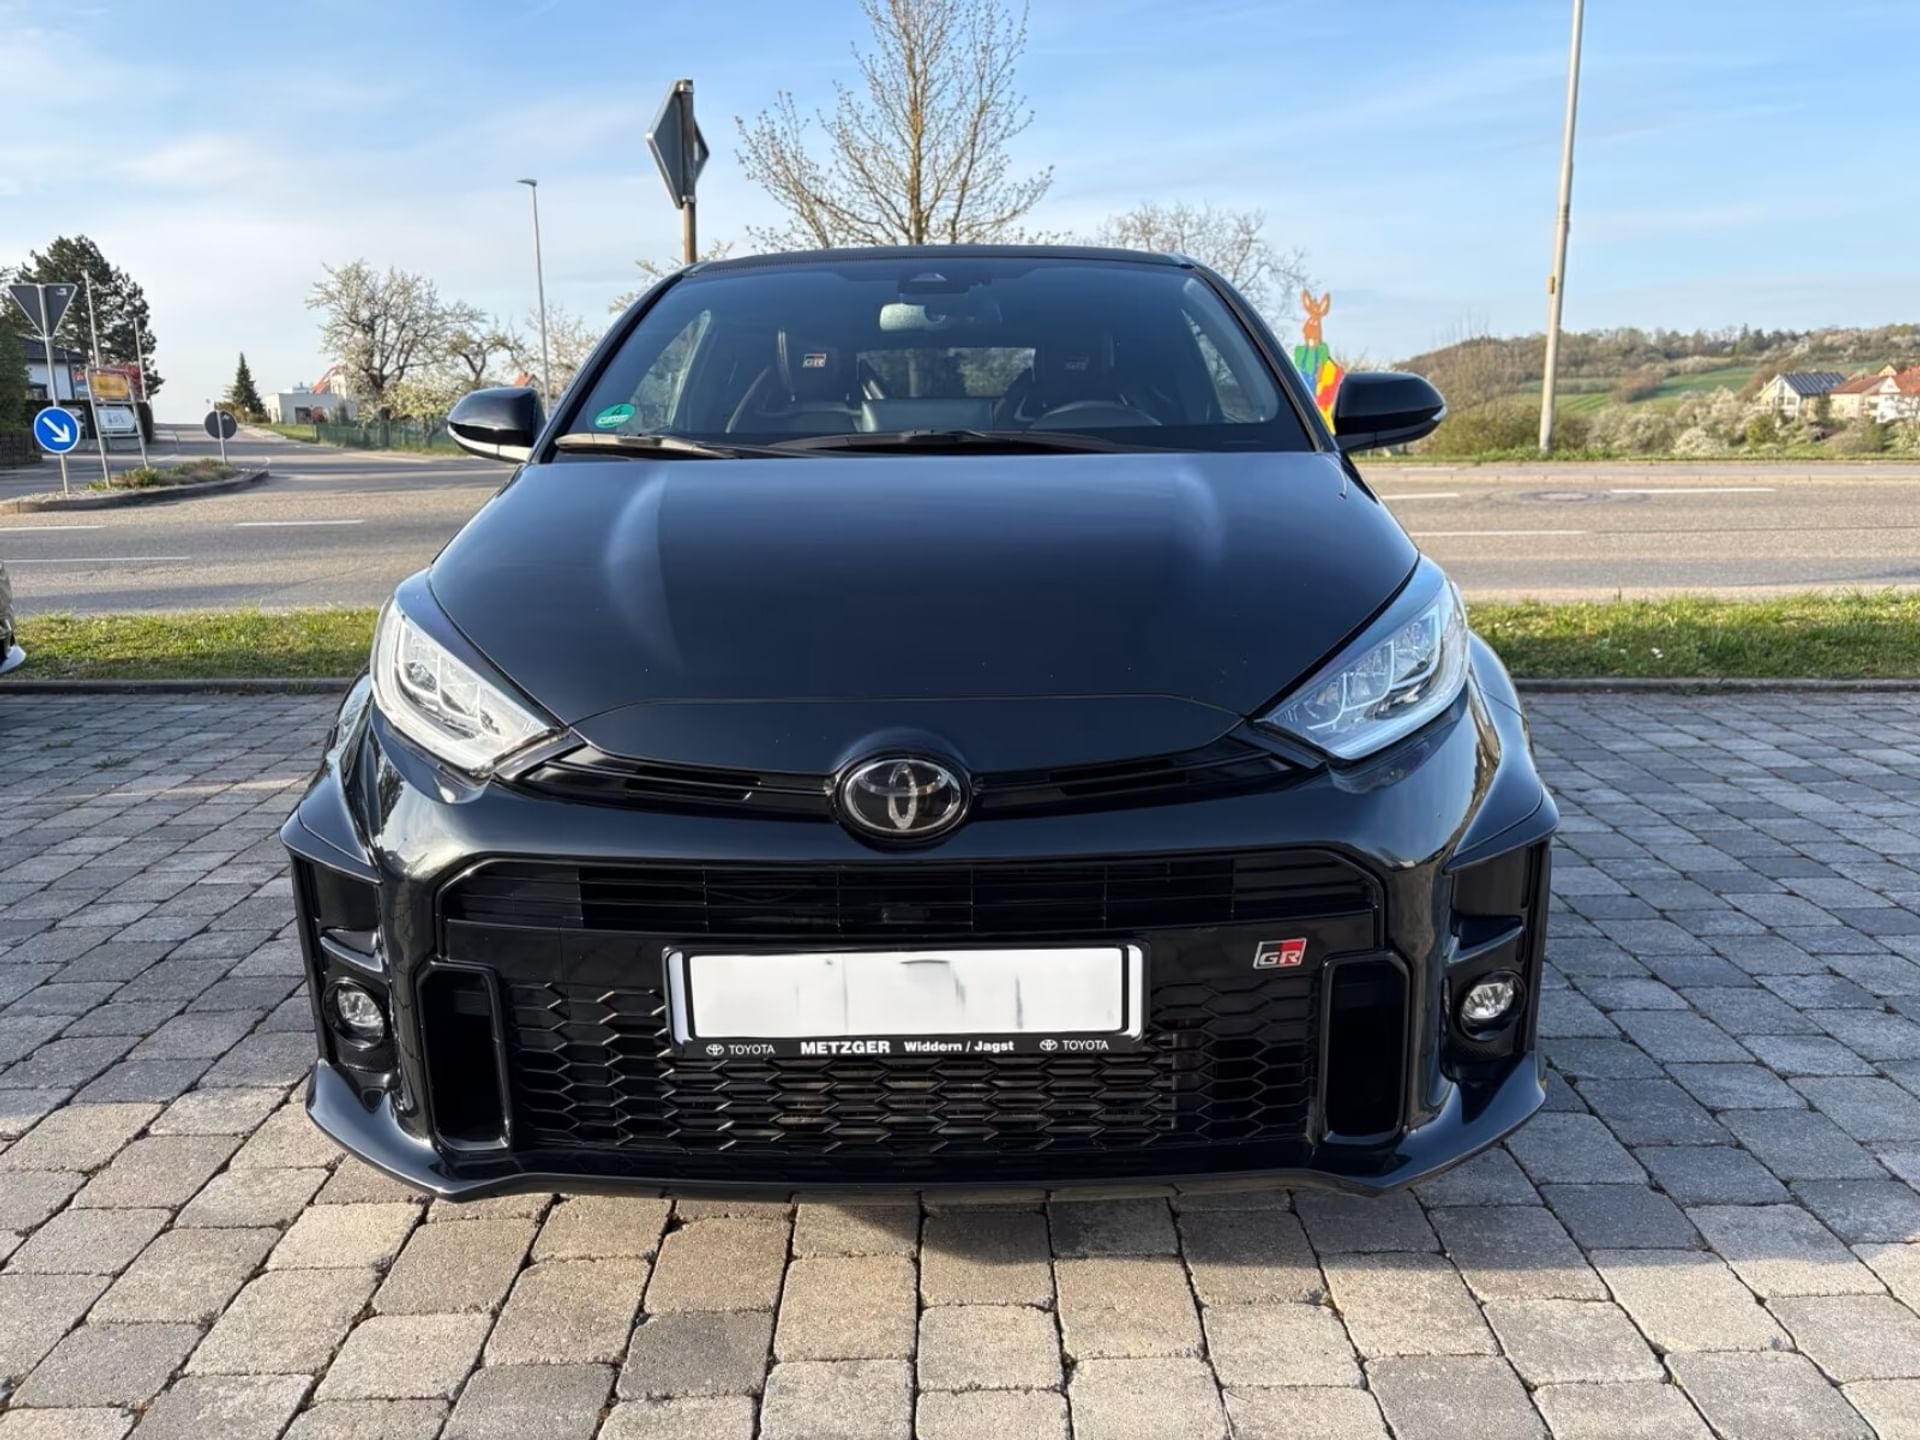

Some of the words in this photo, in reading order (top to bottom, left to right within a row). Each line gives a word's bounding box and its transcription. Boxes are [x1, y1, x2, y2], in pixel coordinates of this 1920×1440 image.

[1259, 950, 1301, 965] GR
[728, 1044, 776, 1055] TOYOTA
[800, 1040, 891, 1055] METZGER
[904, 1041, 962, 1053] Widdern
[974, 1040, 1015, 1054] Jagst
[1061, 1039, 1110, 1051] TOYOTA
